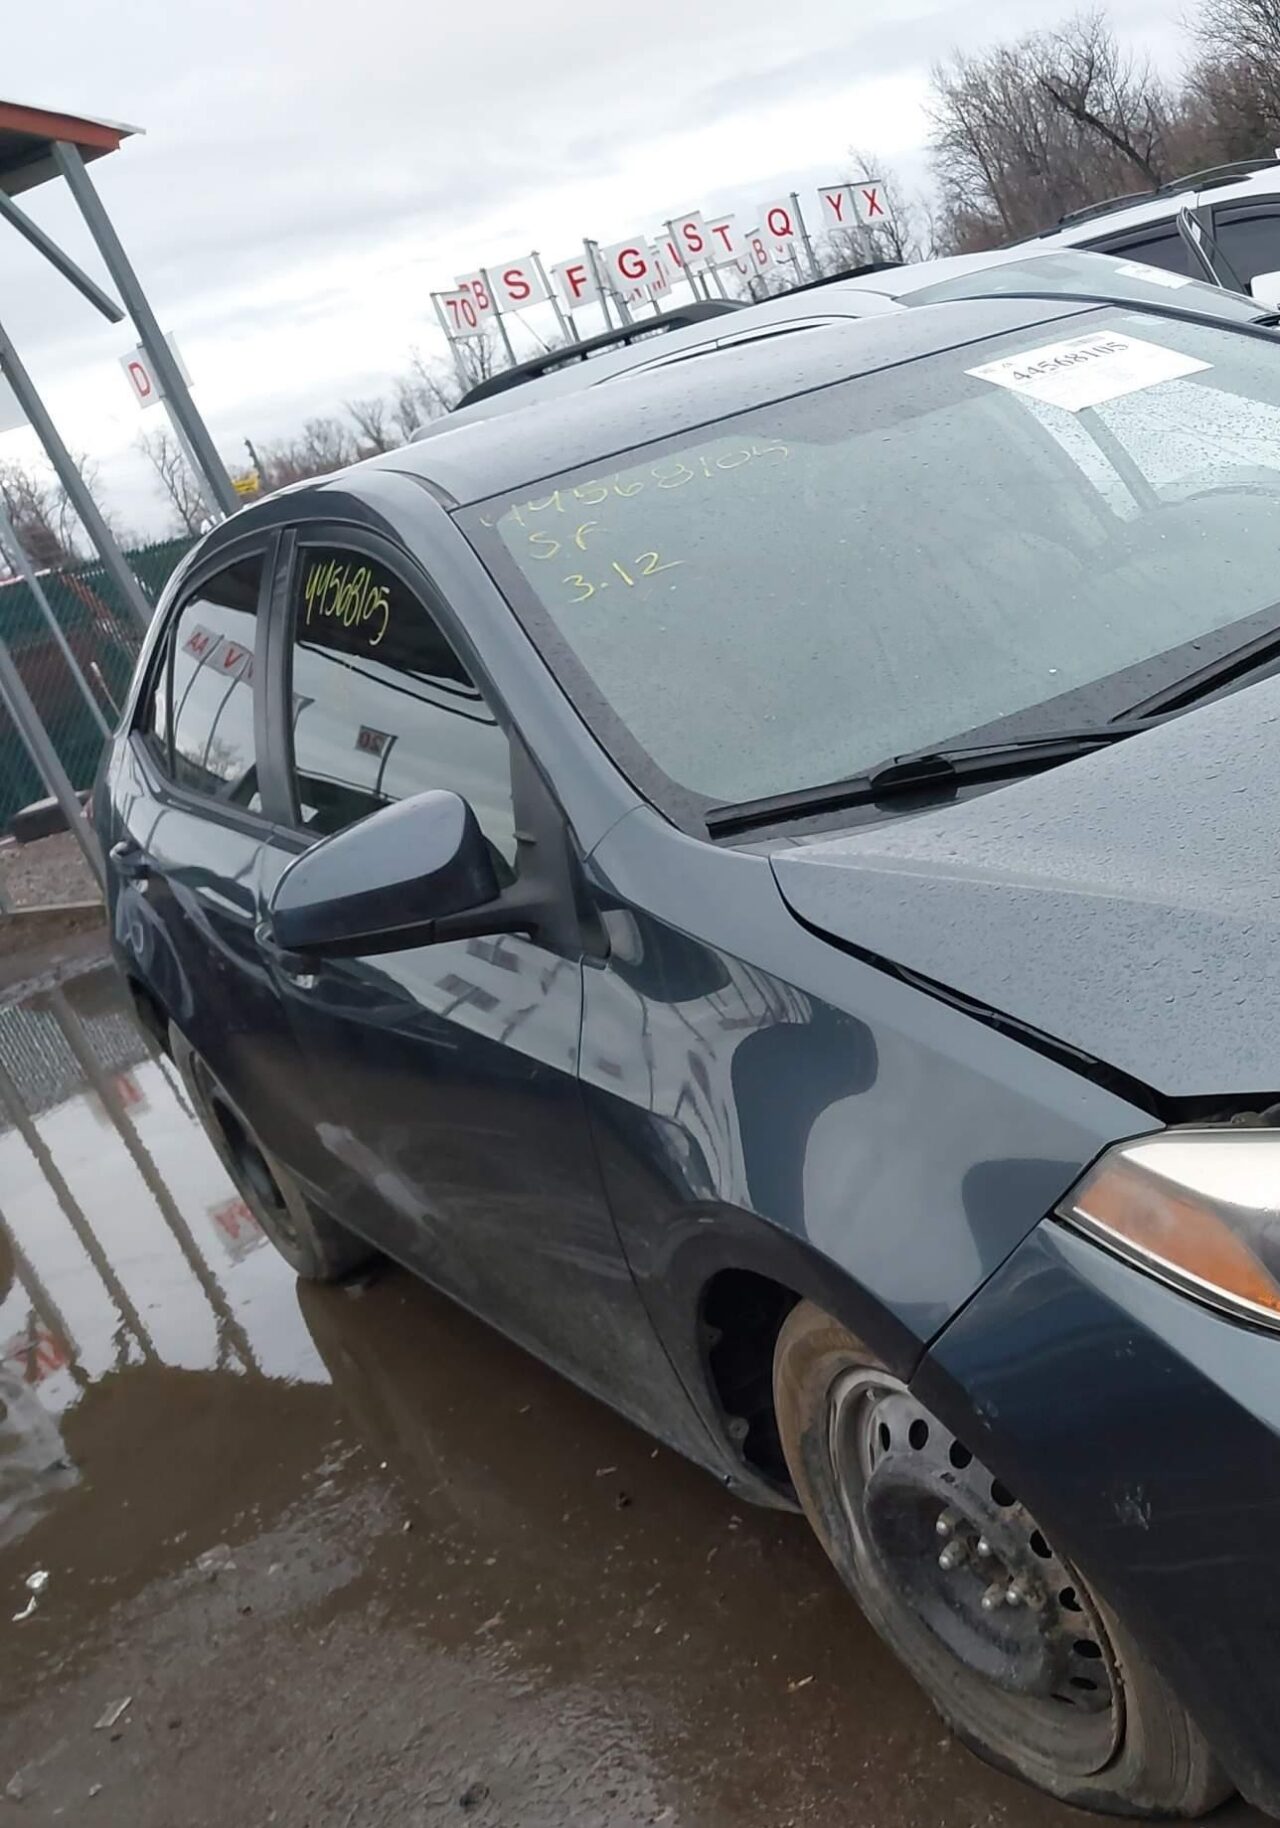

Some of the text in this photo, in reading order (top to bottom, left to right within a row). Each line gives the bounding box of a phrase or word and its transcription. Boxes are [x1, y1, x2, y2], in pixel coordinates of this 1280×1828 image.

[826, 193, 842, 222] Y
[862, 188, 884, 217] X
[683, 223, 703, 252] S
[767, 207, 794, 237] Q
[712, 224, 733, 252] T
[752, 238, 768, 265] B
[618, 248, 647, 279] G
[503, 269, 530, 300] S
[566, 265, 587, 298] F
[446, 298, 477, 329] 70
[1013, 341, 1129, 383] 44568105
[128, 361, 151, 397] D
[562, 551, 688, 602] 3.12
